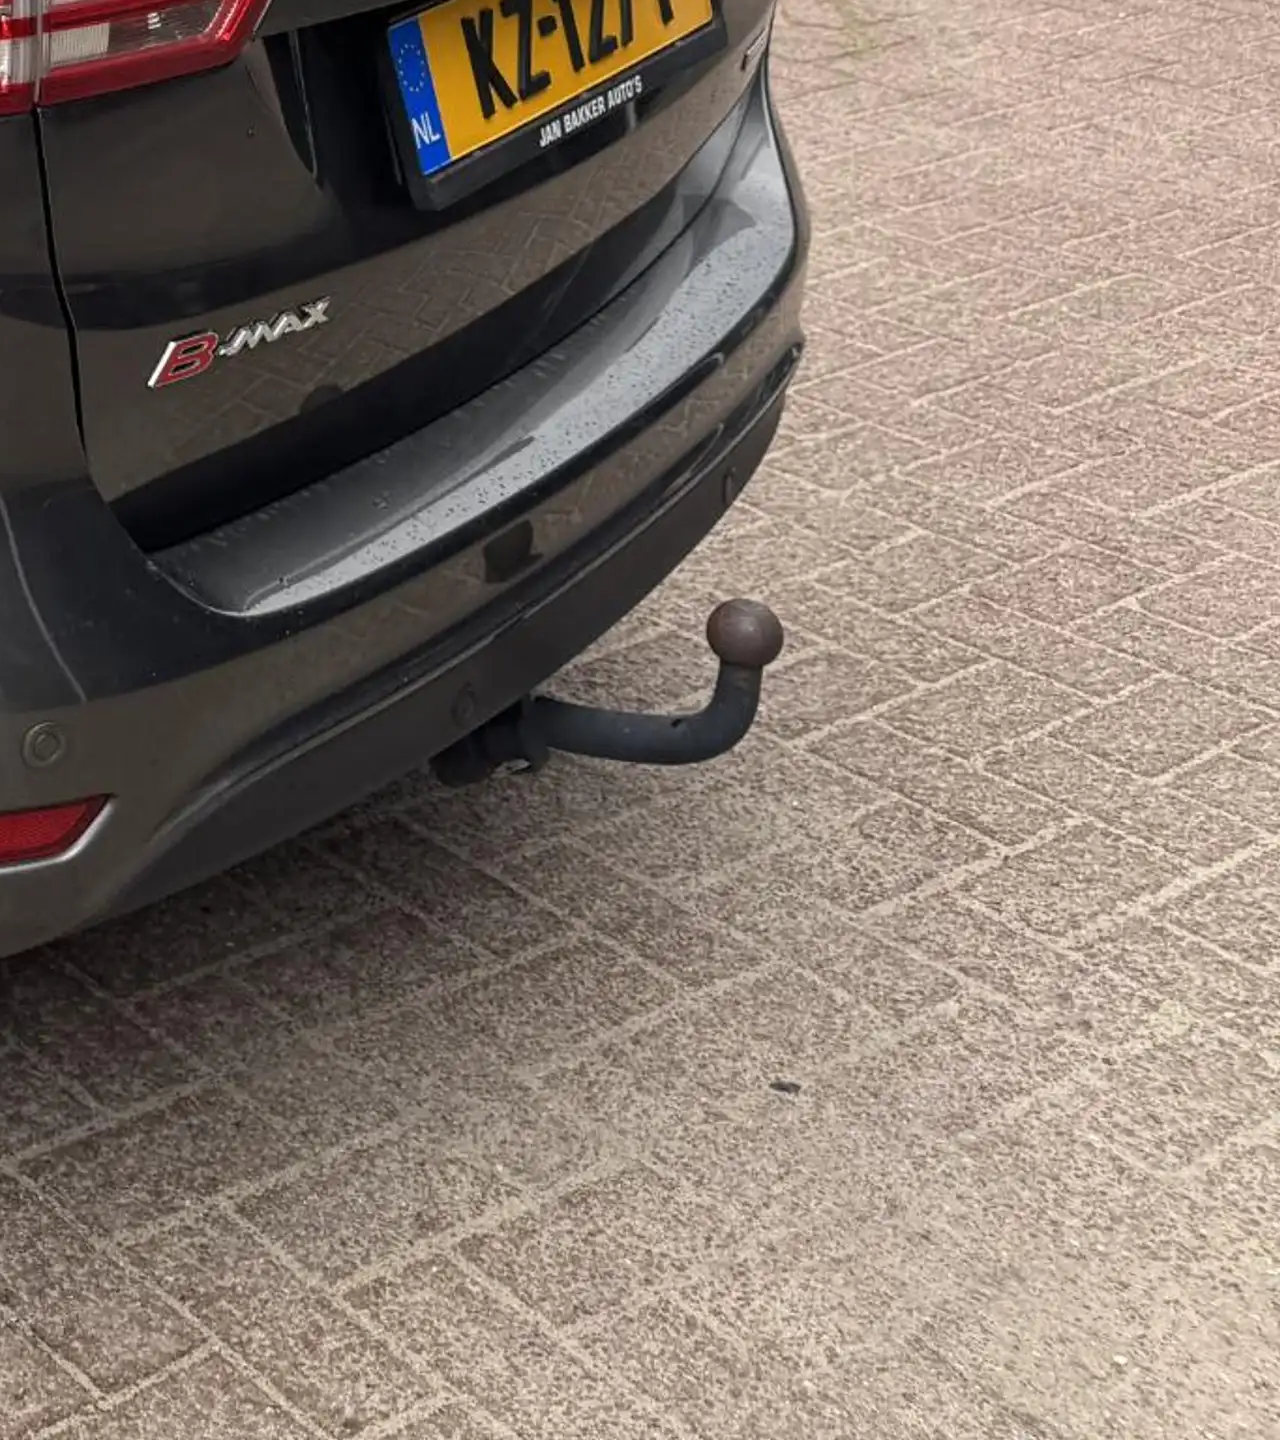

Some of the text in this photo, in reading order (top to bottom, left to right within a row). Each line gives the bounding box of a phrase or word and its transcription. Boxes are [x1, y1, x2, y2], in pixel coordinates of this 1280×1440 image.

[411, 112, 441, 149] NL
[539, 75, 643, 148] JAN BAKKER AUTO'S
[147, 295, 331, 389] B-MAX
